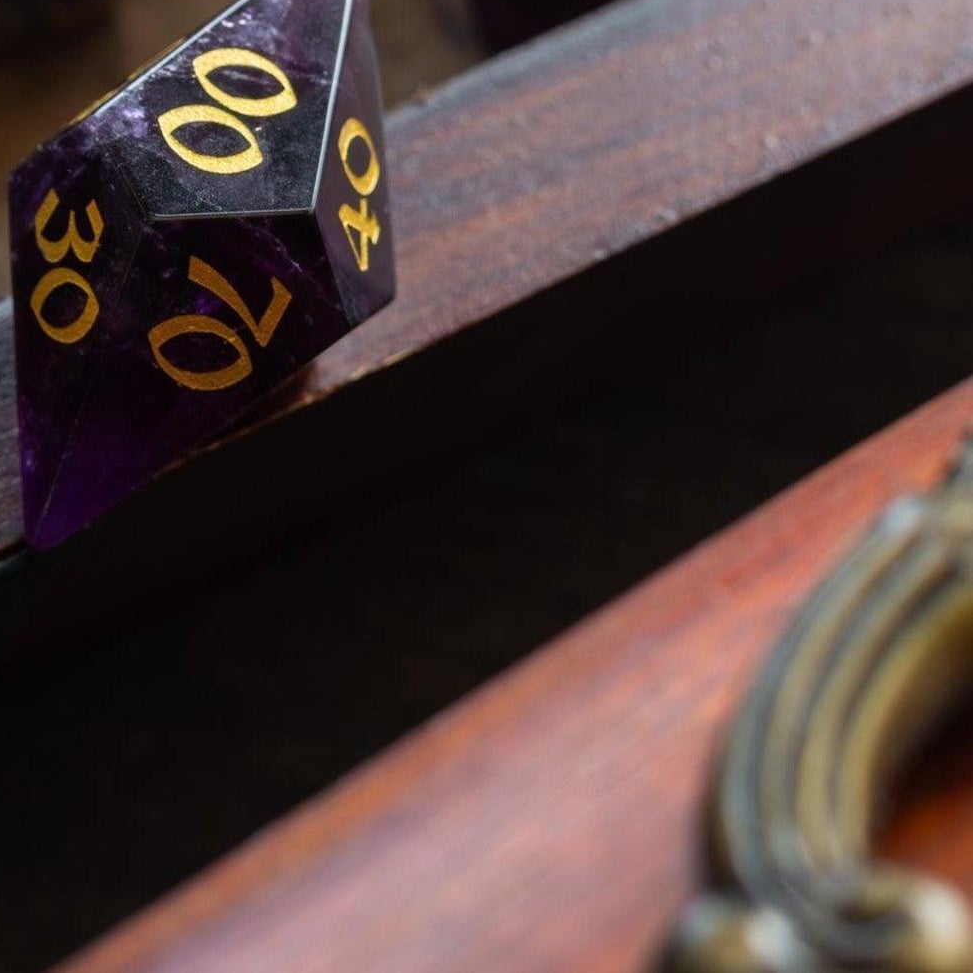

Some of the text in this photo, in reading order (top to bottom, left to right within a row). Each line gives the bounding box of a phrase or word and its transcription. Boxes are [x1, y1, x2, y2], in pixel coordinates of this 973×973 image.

[158, 47, 298, 175] 00
[30, 188, 105, 345] 30
[338, 117, 381, 272] 40
[147, 255, 293, 393] 70
